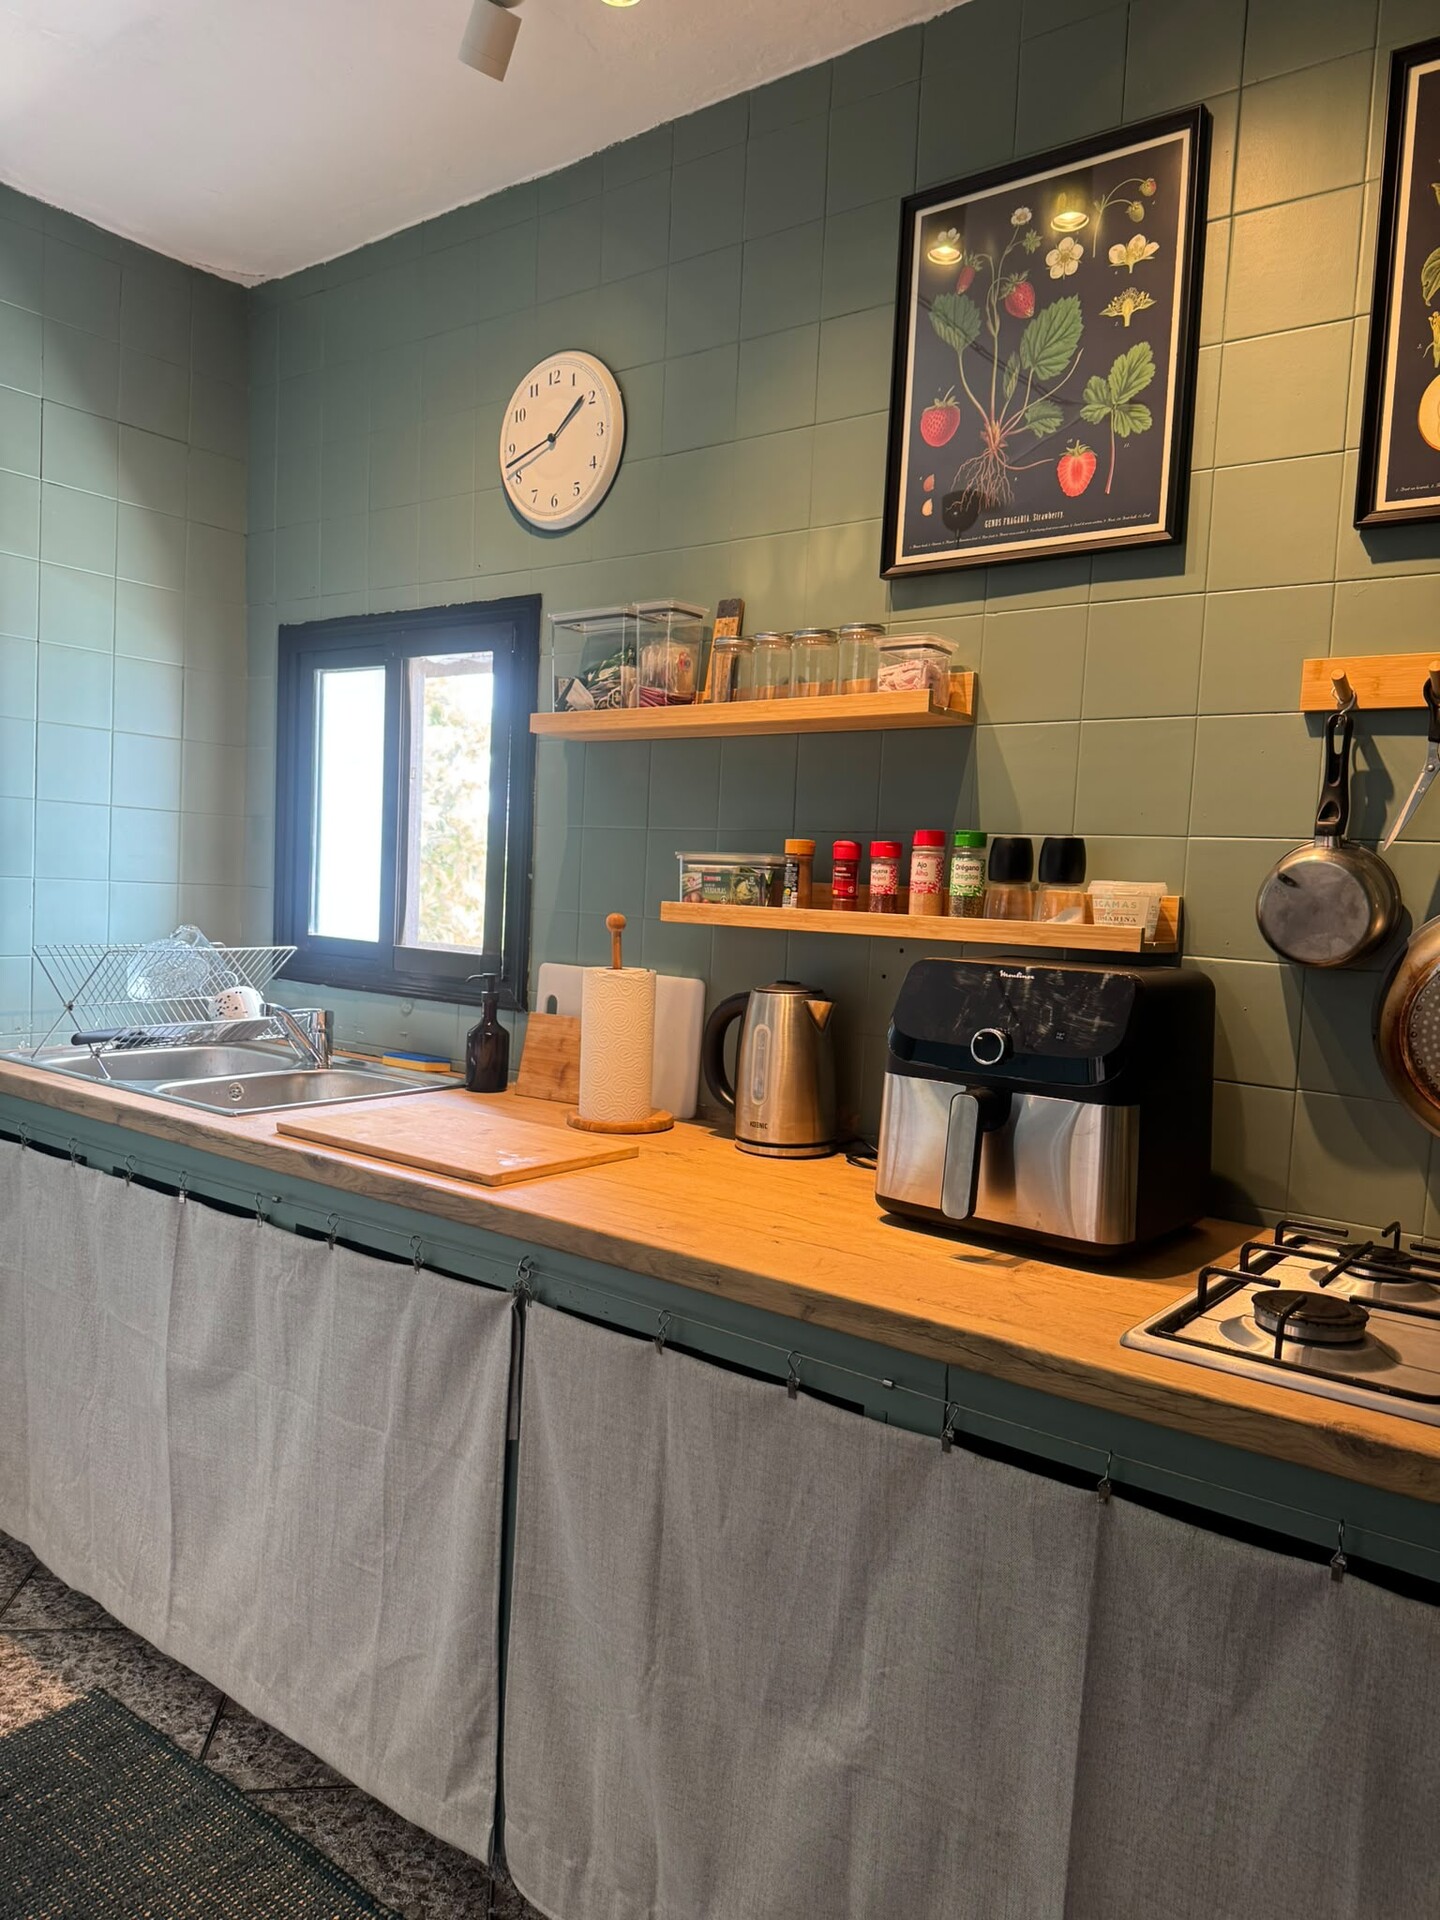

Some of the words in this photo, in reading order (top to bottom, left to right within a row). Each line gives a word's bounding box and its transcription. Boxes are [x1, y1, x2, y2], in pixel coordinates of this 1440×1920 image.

[548, 369, 561, 386] 12
[571, 372, 576, 387] 1
[530, 383, 539, 398] 11
[588, 390, 596, 405] 2
[514, 407, 526, 423] 10
[596, 421, 604, 436] 3
[508, 443, 516, 458] 9
[589, 455, 597, 469] 4
[515, 470, 523, 485] 8
[531, 489, 538, 504] 7
[573, 481, 580, 497] 5
[550, 494, 558, 508] 6
[917, 861, 928, 869] Ajo
[955, 863, 980, 873] Orégano
